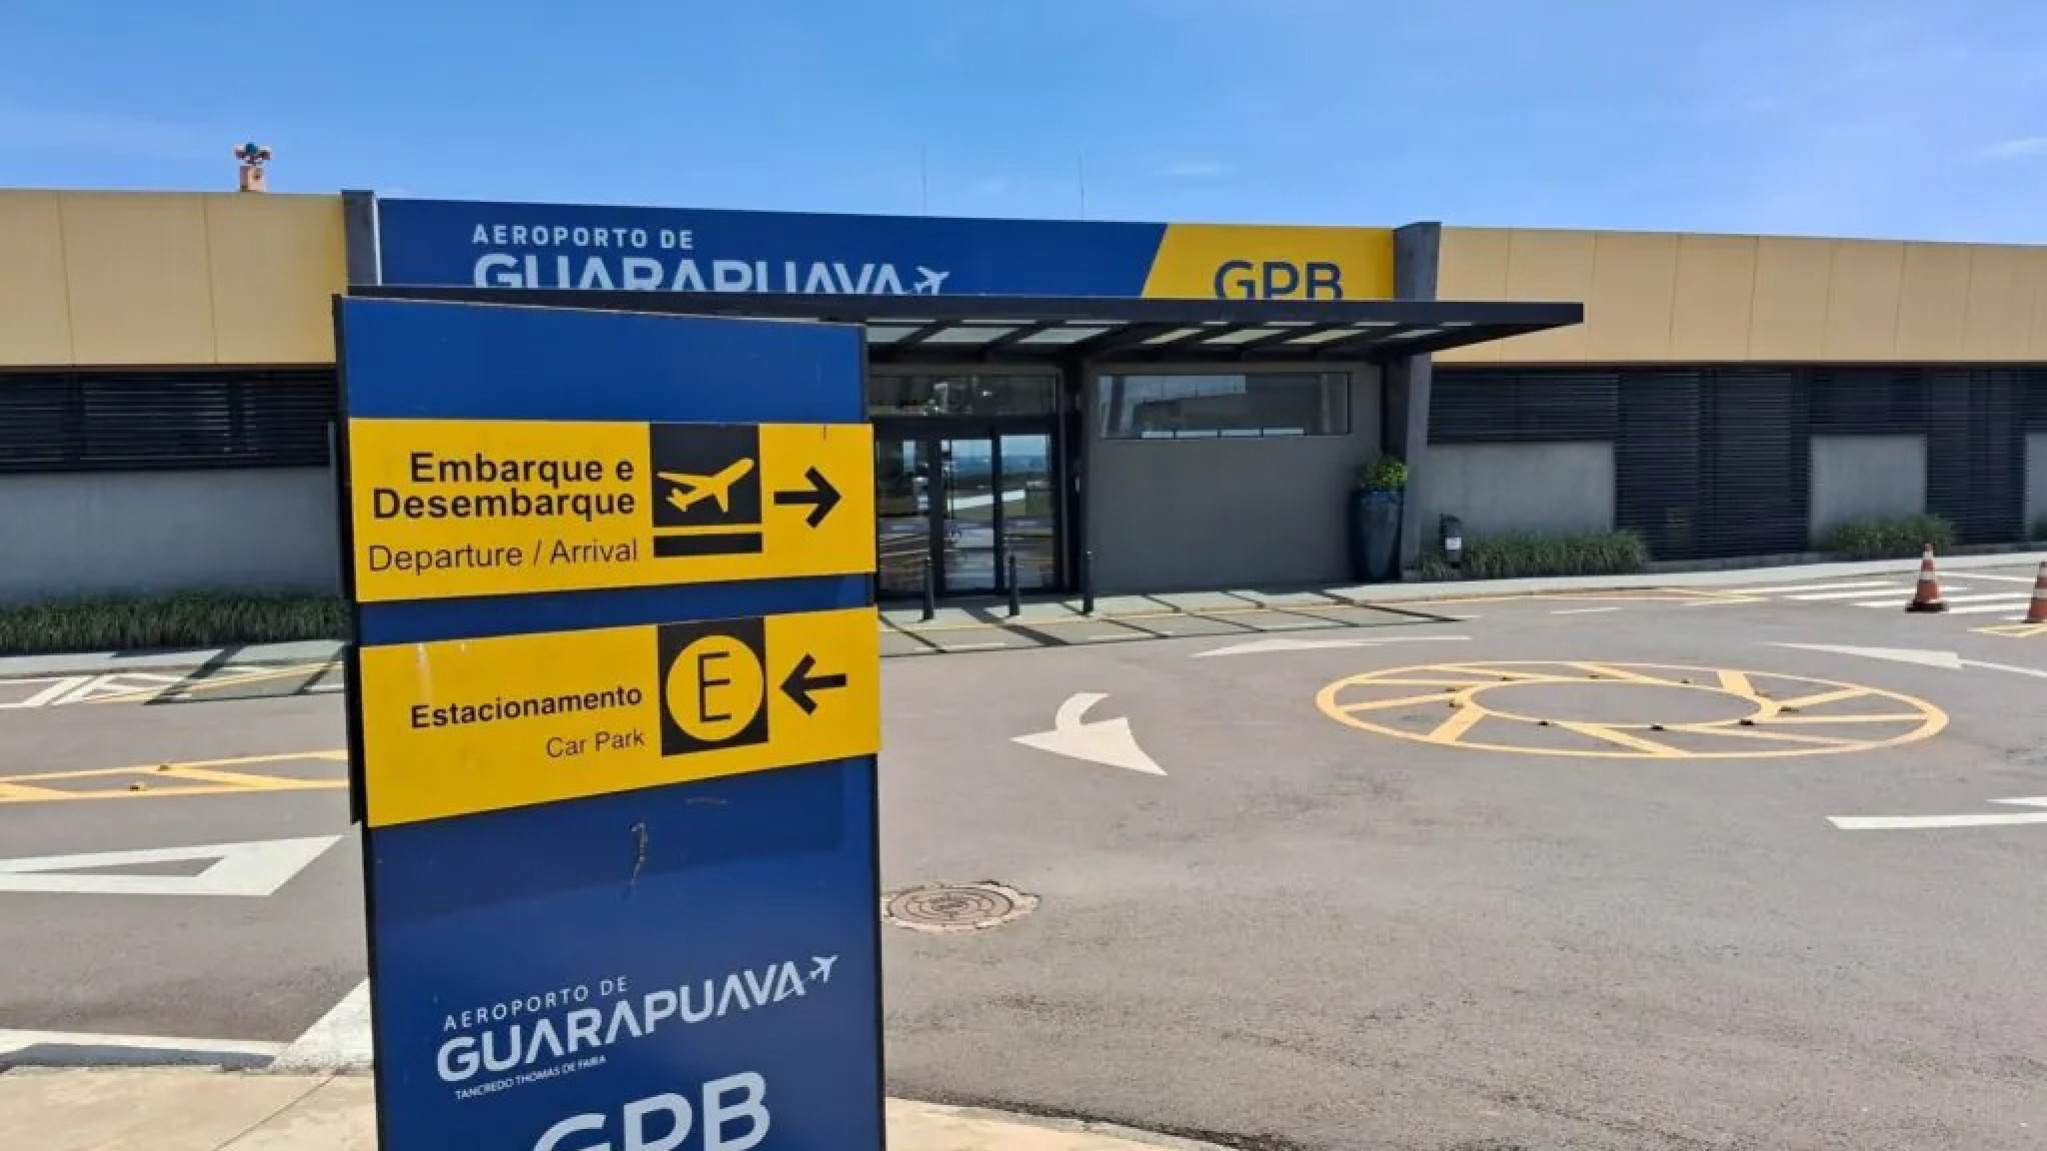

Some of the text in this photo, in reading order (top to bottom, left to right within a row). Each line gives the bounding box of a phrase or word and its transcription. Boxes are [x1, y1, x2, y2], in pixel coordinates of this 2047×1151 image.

[472, 223, 694, 250] AEROPORTO DE
[1214, 259, 1344, 301] GPB
[410, 452, 635, 488] Embarque e
[372, 488, 636, 522] Desembarque
[368, 538, 638, 576] Departure / Arrival
[697, 651, 732, 723] E
[410, 685, 643, 729] Estacionamento
[545, 728, 646, 758] Car Park
[436, 960, 806, 1082] GUARAPUAVA
[443, 976, 629, 1032] AEROPORTO DE
[455, 1078, 515, 1100] TANCREDO
[515, 1066, 561, 1086] THOMAS
[561, 1061, 577, 1075] DE
